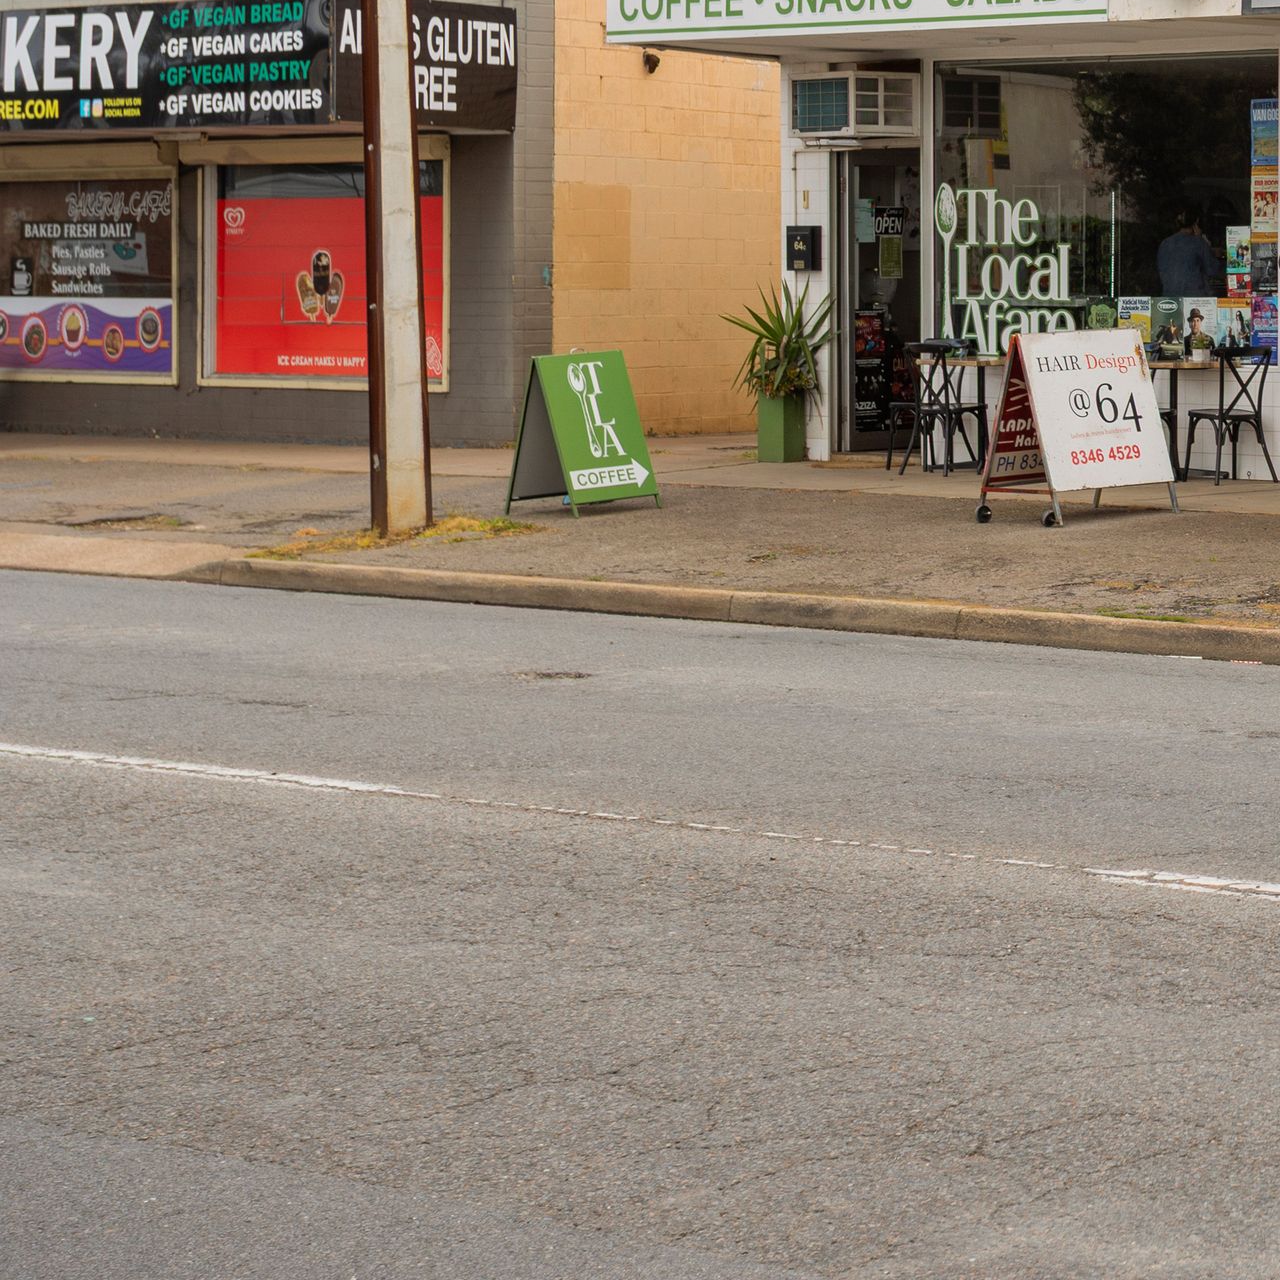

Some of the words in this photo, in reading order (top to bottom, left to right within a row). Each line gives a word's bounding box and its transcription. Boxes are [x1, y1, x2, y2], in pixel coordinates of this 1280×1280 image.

[194, 5, 246, 27] VEGAN
[251, 1, 304, 24] BREAD
[4, 10, 154, 93] KERY
[192, 34, 245, 57] VEGAN
[250, 30, 304, 53] CAKES
[427, 16, 516, 67] GLUTEN
[191, 63, 245, 85] VEGAN
[250, 60, 311, 81] PASTRY
[413, 65, 457, 112] REE
[103, 98, 125, 107] FOLLOW
[126, 98, 133, 106] US
[133, 97, 142, 106] ON
[192, 91, 245, 114] VEGAN
[250, 88, 323, 111] COOKIES
[104, 109, 123, 117] SOCIAL
[123, 108, 141, 117] MEDIA
[875, 217, 902, 234] OPEN
[956, 189, 1039, 245] The
[25, 223, 61, 238] BAKED
[64, 223, 97, 238] FRESH
[100, 222, 133, 238] DAILY
[52, 263, 87, 279] Sausage
[89, 263, 112, 276] Rolls
[955, 244, 1071, 301] Local
[52, 280, 104, 295] Sandwiches
[291, 355, 313, 366] CREAM
[314, 356, 335, 367] MAKES
[343, 356, 366, 368] HAPPY
[1036, 355, 1081, 373] HAIR
[1085, 353, 1137, 374] Design
[996, 456, 1016, 472] PH
[1071, 448, 1105, 465] 8346
[1108, 444, 1141, 460] 4529
[576, 467, 637, 487] COFFEE
